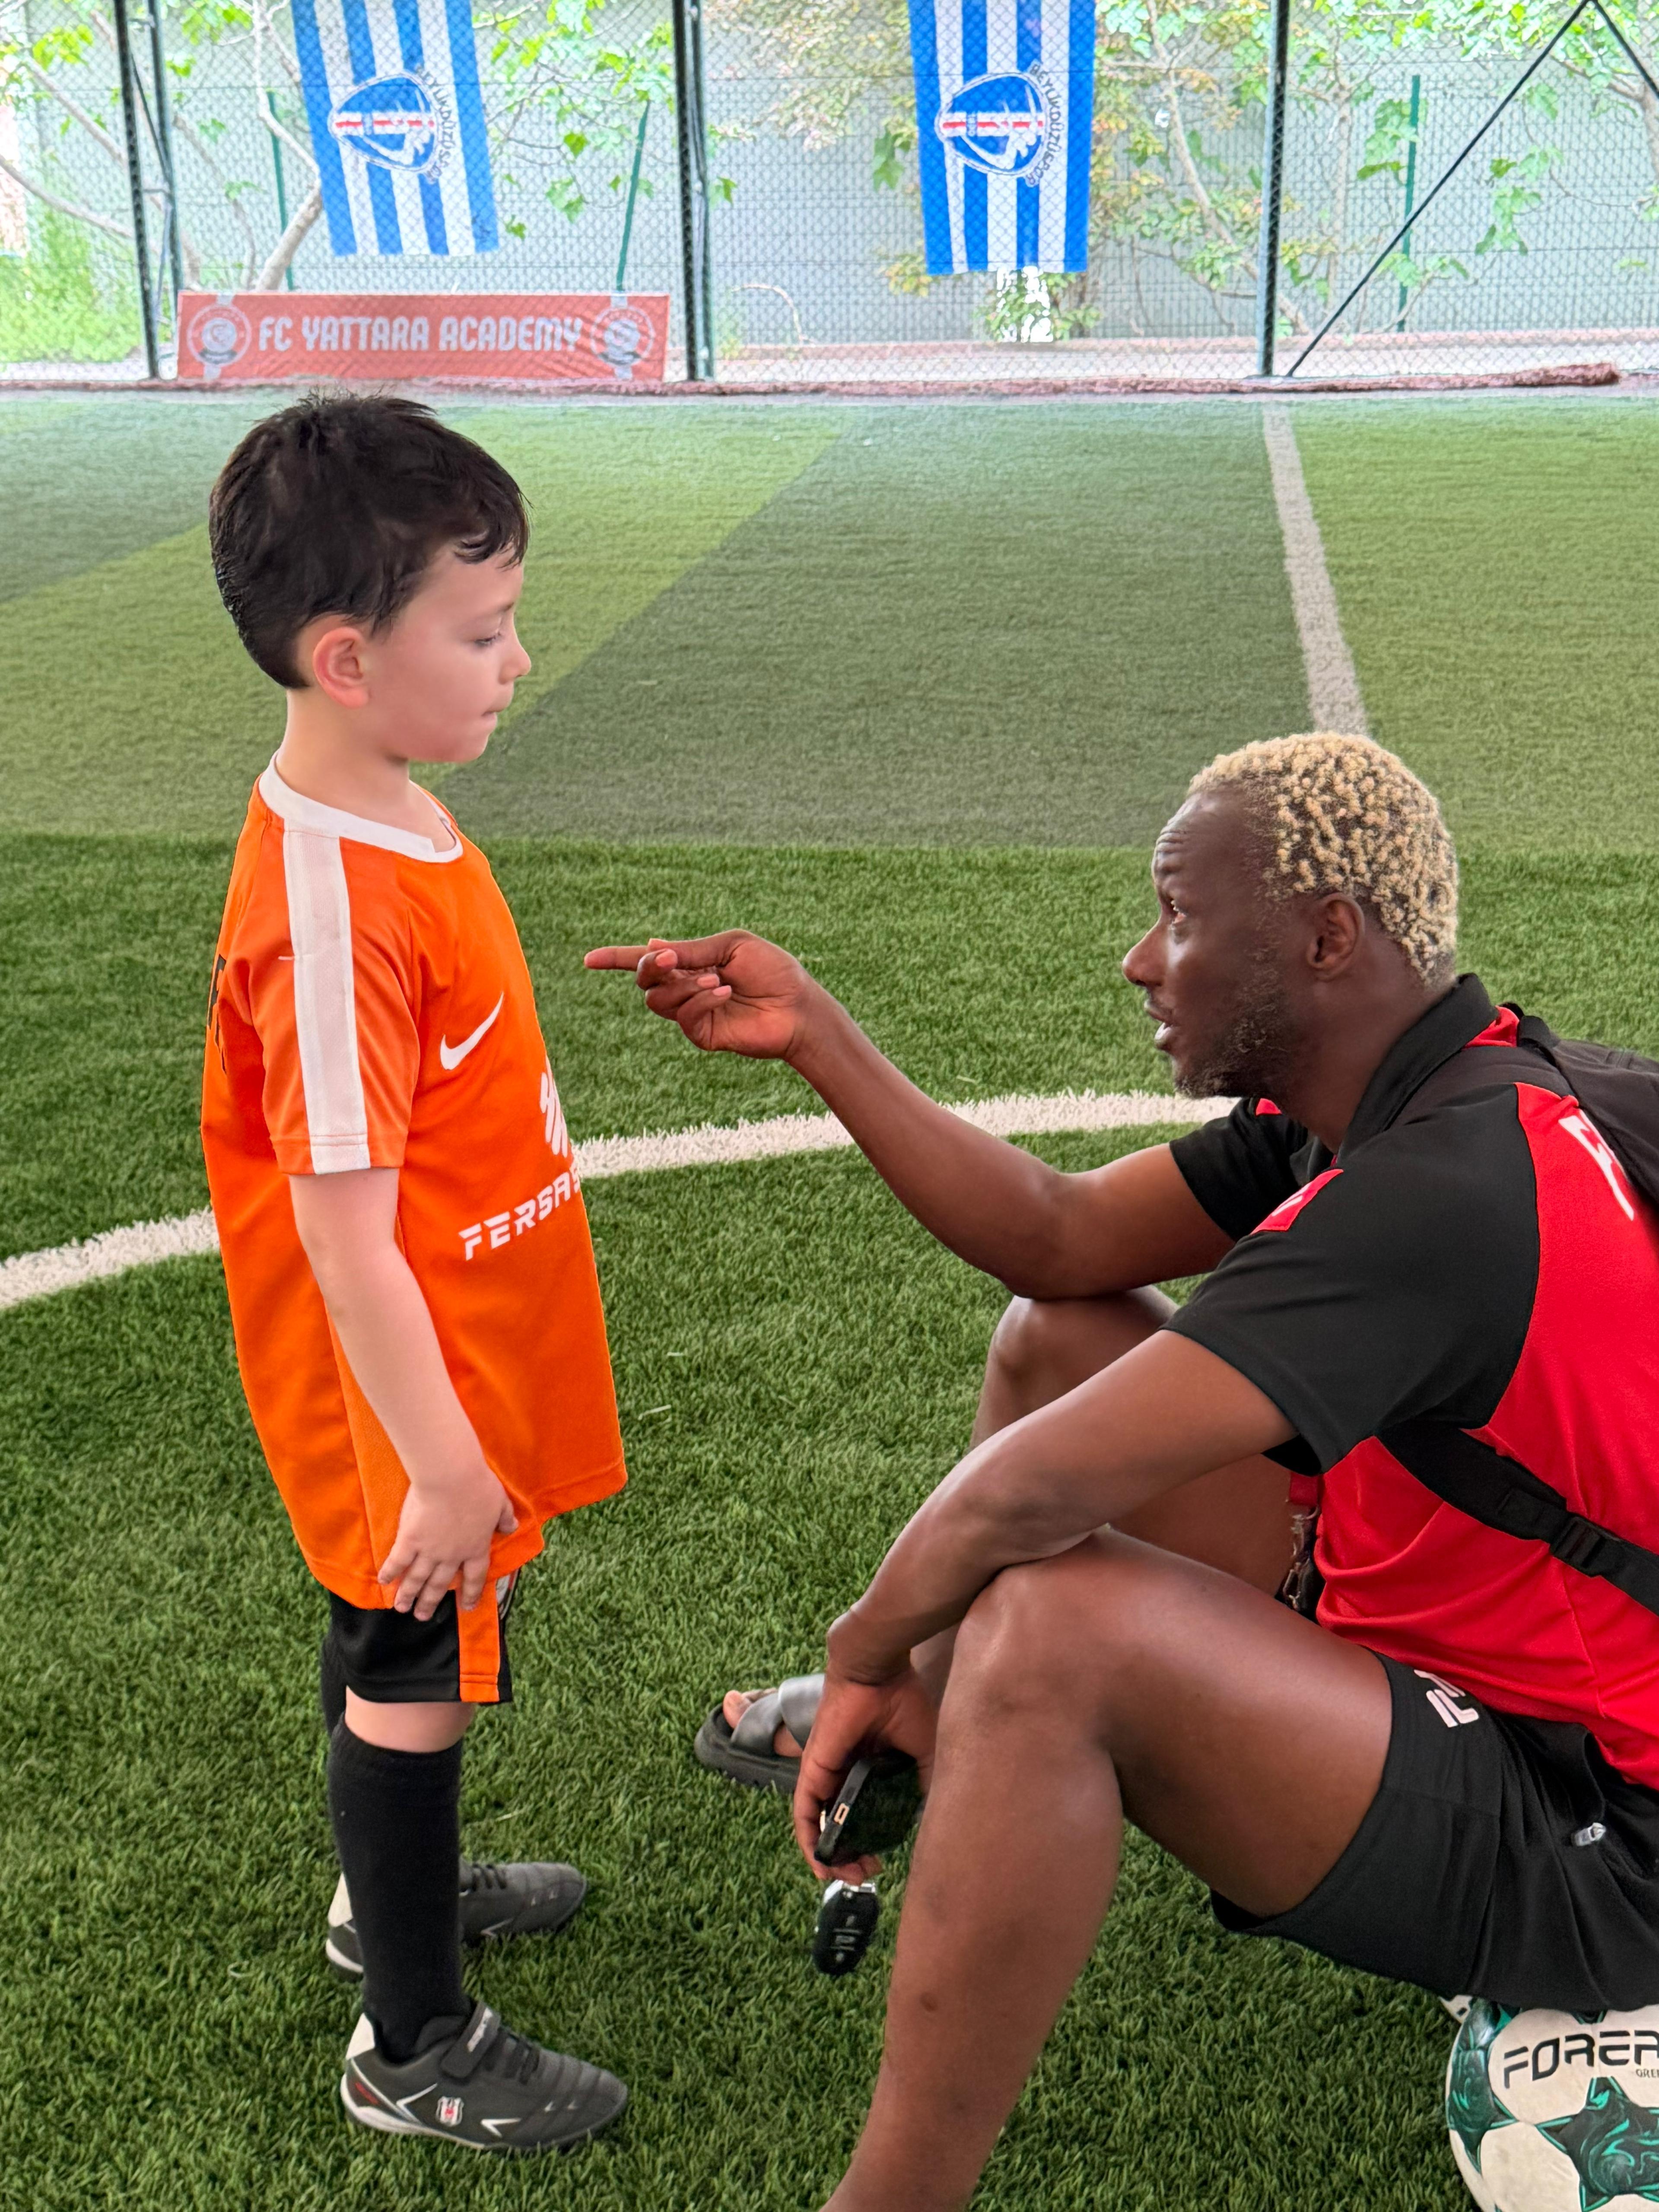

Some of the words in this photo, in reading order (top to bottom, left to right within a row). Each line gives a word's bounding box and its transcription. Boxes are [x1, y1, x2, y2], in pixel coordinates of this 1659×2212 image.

[259, 316, 293, 351] FC
[302, 316, 429, 351] YATTARA
[439, 316, 582, 351] ACADEMY
